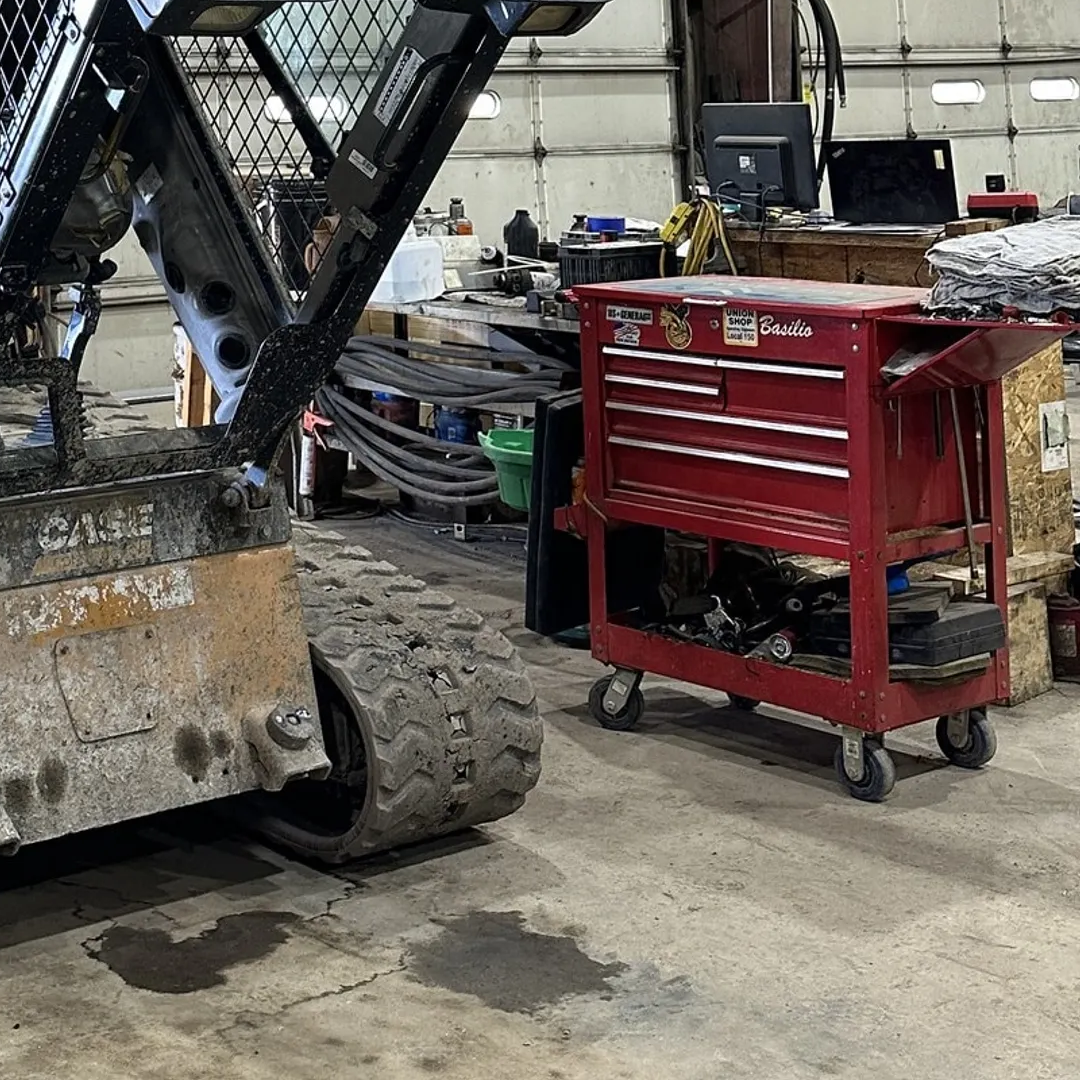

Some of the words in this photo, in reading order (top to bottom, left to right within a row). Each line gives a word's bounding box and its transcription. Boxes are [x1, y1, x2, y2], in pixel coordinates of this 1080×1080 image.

[726, 308, 755, 318] UNION
[728, 317, 753, 327] SHOP
[759, 315, 814, 338] Basilio
[37, 503, 155, 552] CASE
